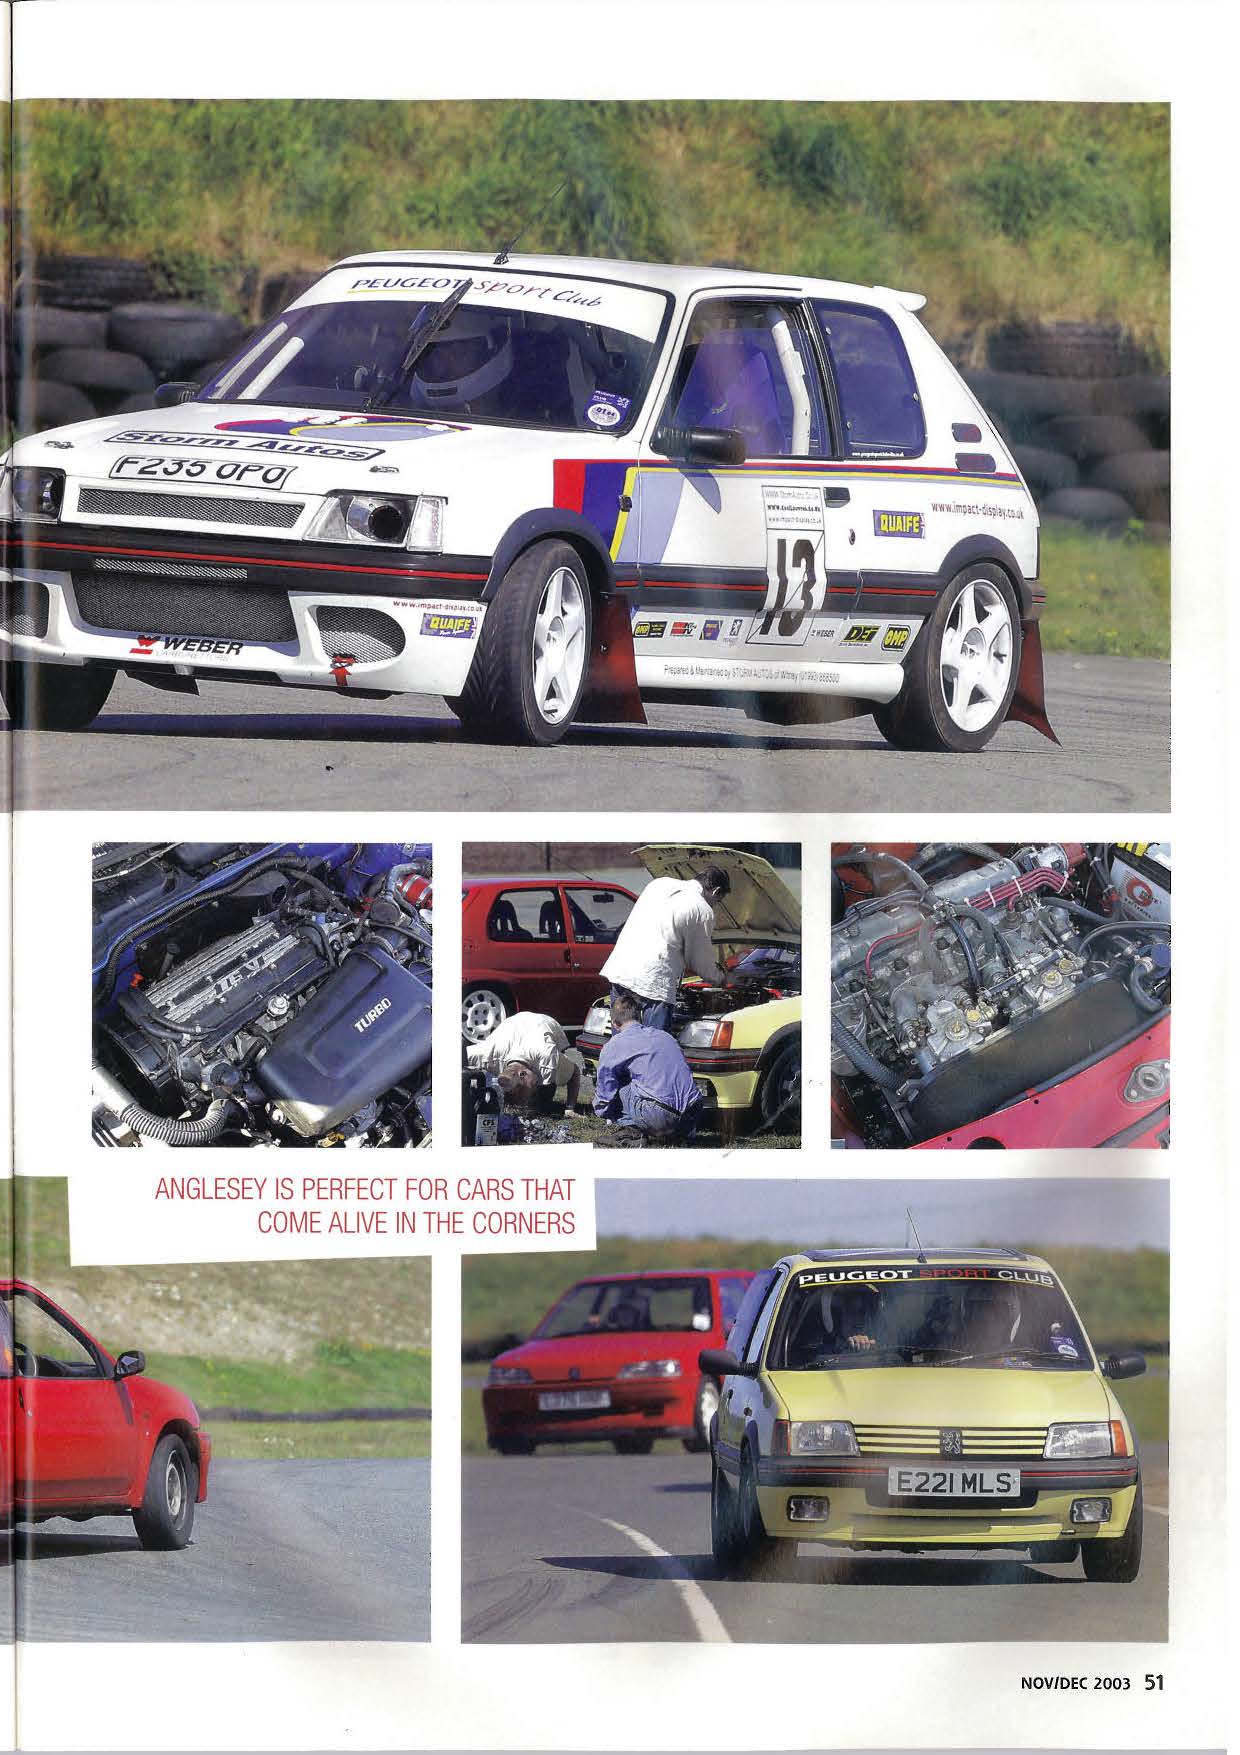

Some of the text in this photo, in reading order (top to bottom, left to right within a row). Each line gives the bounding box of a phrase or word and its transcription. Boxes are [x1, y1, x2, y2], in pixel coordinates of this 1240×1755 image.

[473, 278, 552, 301] sport
[553, 289, 602, 307] Club
[117, 432, 373, 459] Storm Autos
[115, 456, 207, 478] F235
[879, 513, 920, 534] QUAIFE
[759, 538, 817, 636] 13
[431, 616, 472, 632] QUAIFE
[162, 636, 244, 656] WEBER
[354, 998, 392, 1033] TURBO
[154, 1176, 576, 1201] ANGLESEY IS PERFECT FOR CARS THAT
[257, 1210, 576, 1235] COME ALIVE IN THE CORNERS
[798, 1267, 1054, 1287] PEUGEOT SPORT CLUB
[897, 1470, 1012, 1495] E221 MLS
[1021, 1673, 1164, 1691] NOV/DEC 2003 51
